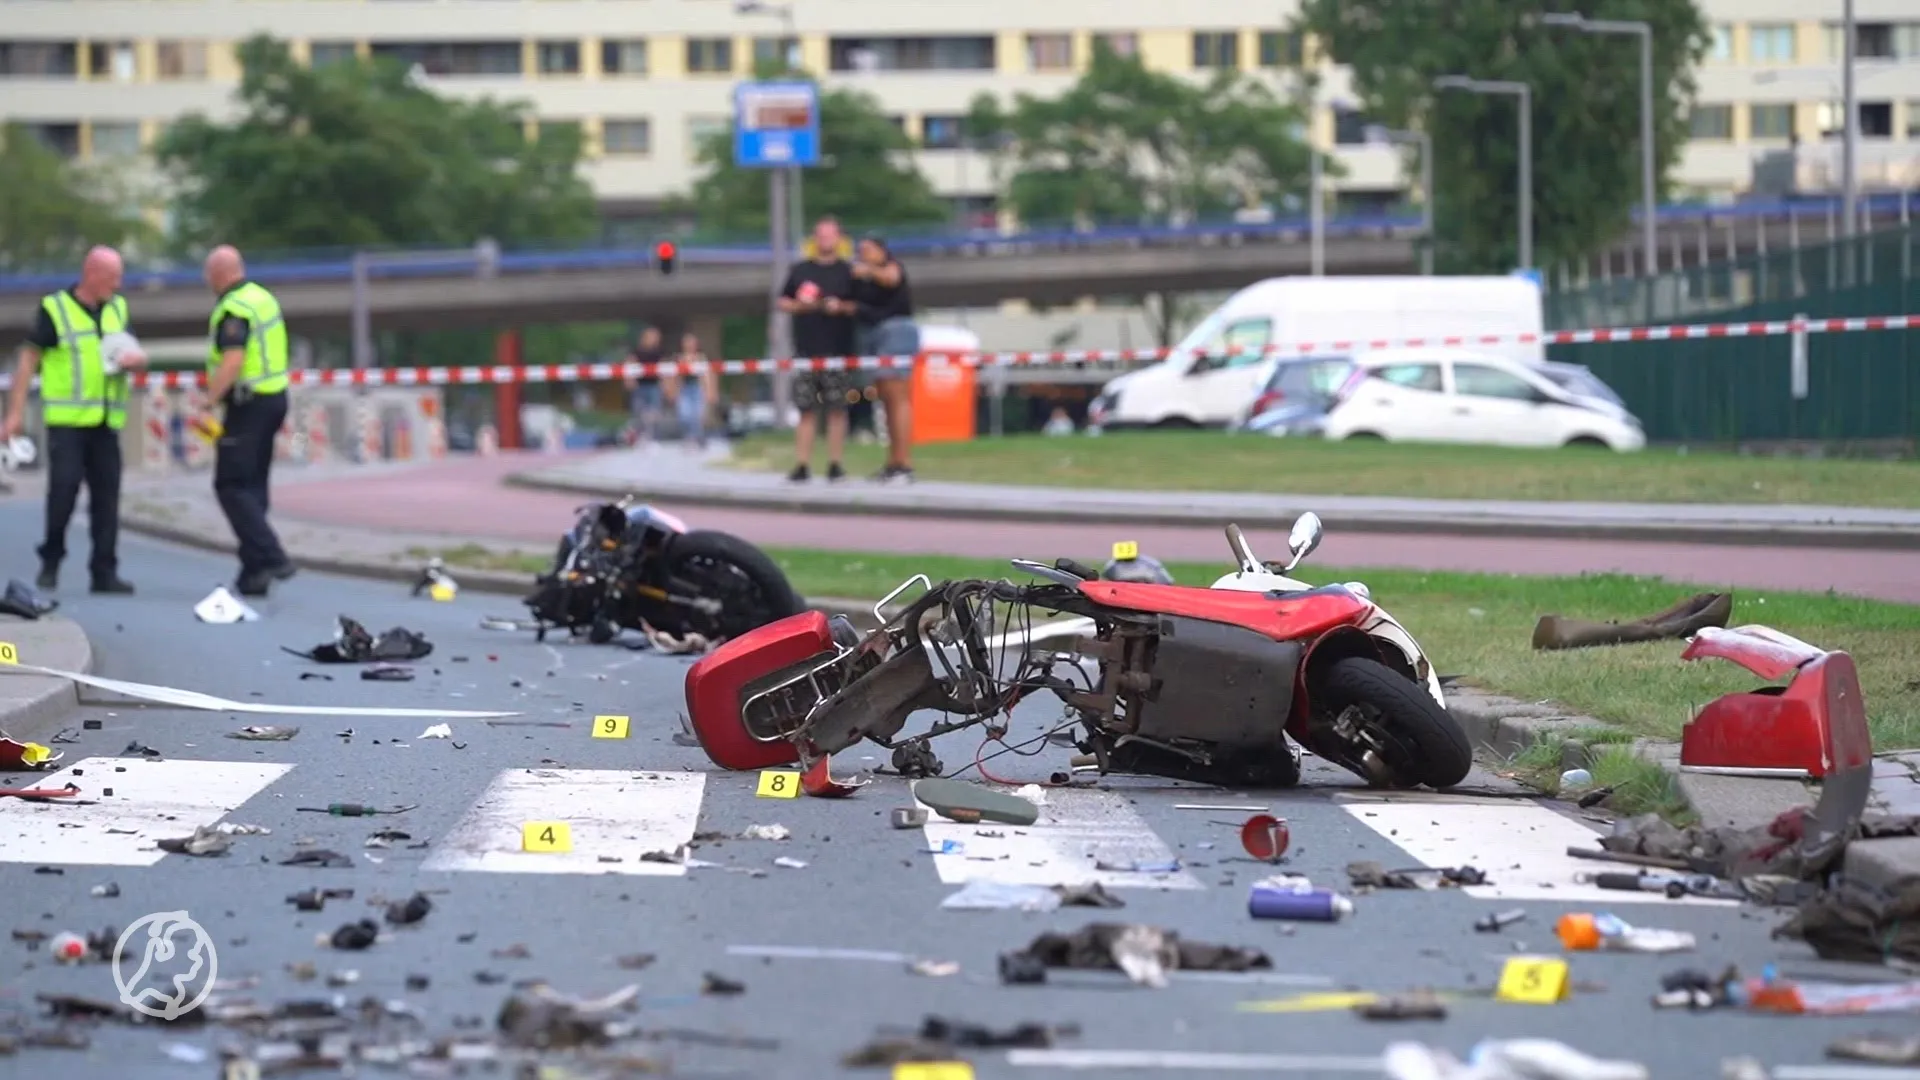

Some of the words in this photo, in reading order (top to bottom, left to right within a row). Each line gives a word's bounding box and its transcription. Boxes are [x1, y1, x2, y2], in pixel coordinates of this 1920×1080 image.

[604, 718, 616, 734] 9
[771, 774, 785, 792] 8
[539, 826, 556, 845] 4
[1521, 963, 1544, 991] 5
